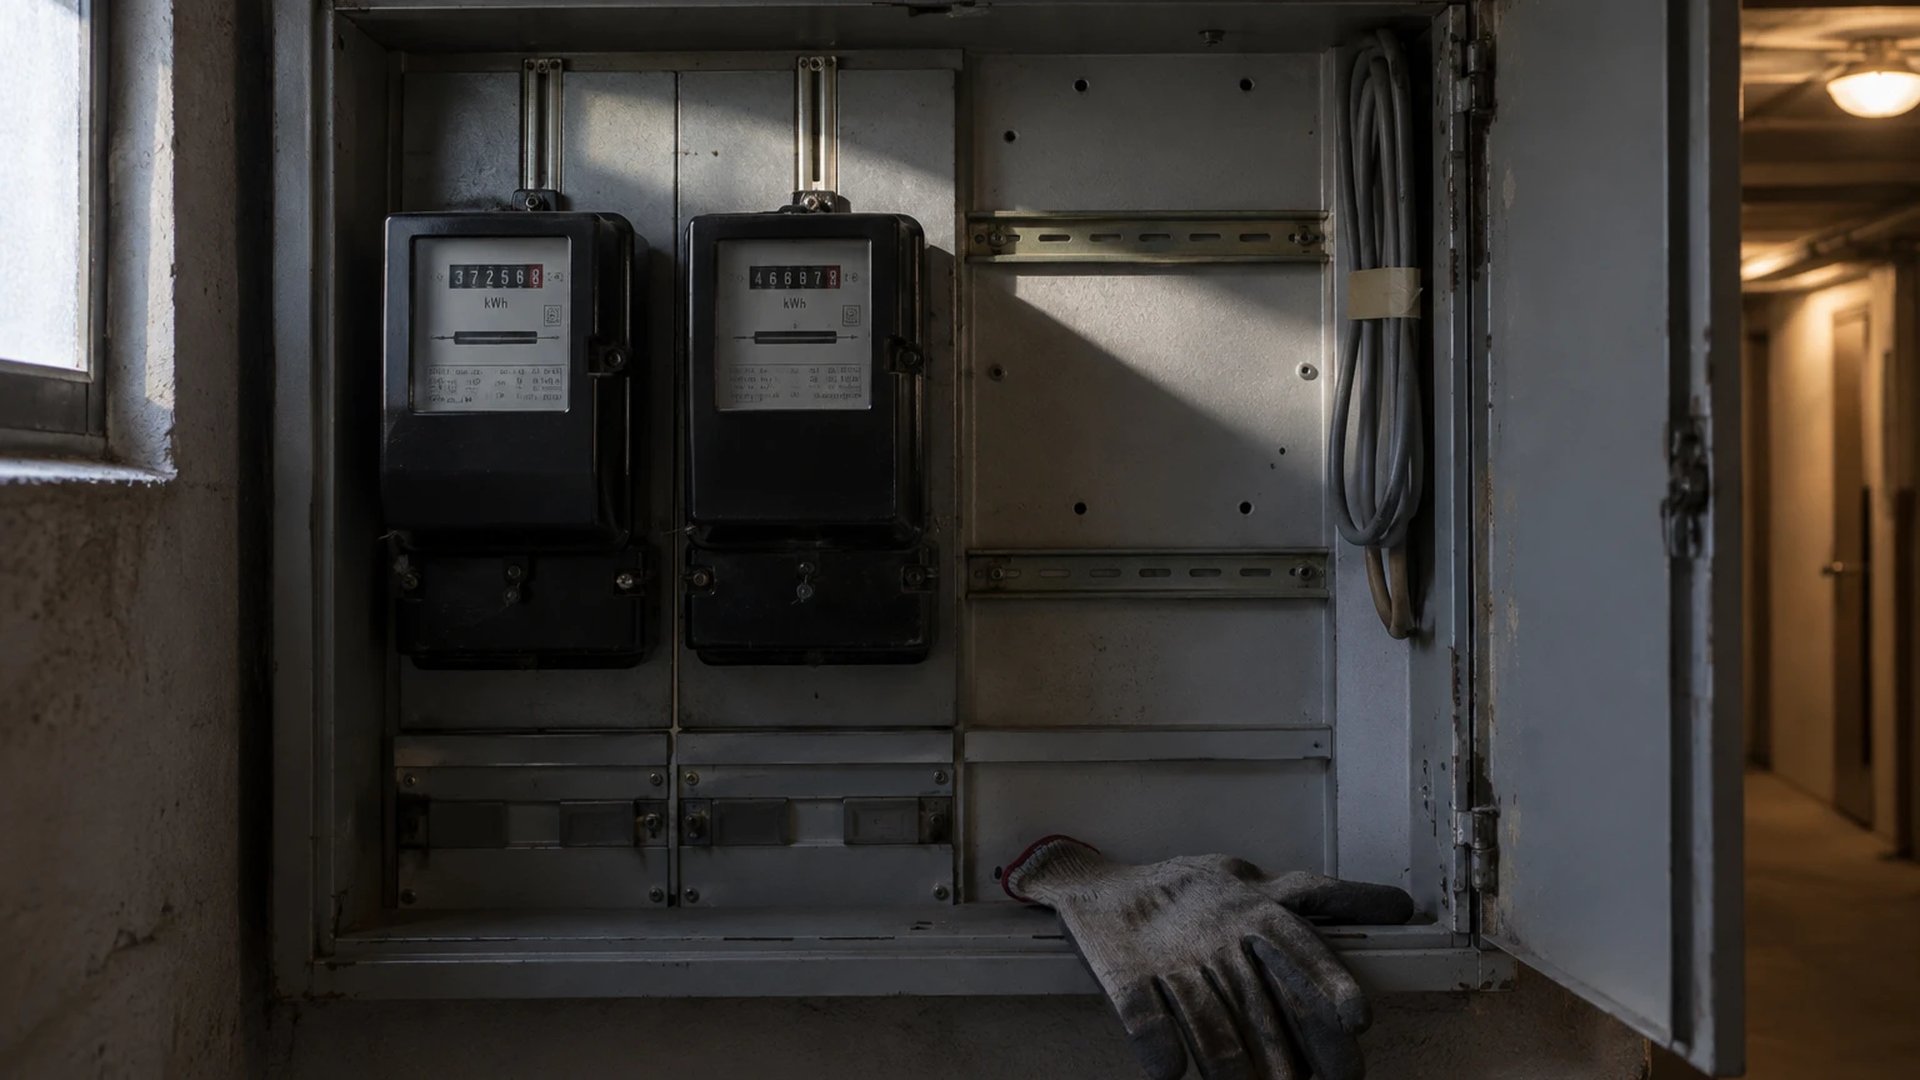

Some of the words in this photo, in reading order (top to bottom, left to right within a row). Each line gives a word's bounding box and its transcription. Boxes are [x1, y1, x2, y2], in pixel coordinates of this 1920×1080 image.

[455, 268, 540, 285] 372568
[484, 296, 508, 309] kWh
[783, 297, 807, 309] kWh
